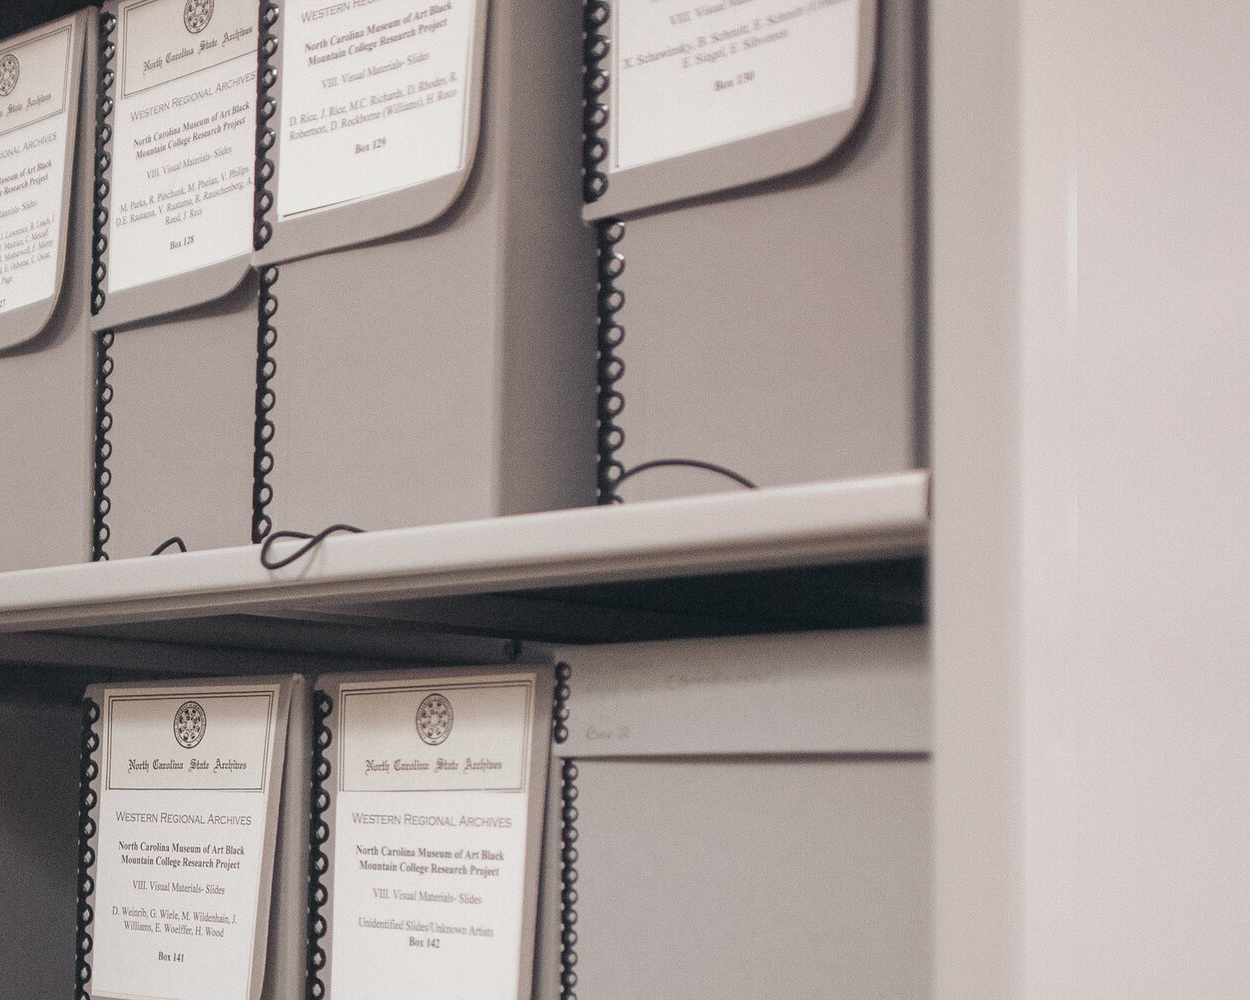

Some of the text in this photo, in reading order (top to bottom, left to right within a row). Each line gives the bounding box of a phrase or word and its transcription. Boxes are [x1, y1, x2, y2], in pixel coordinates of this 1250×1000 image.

[301, 3, 350, 23] WESTERN
[305, 39, 328, 51] North
[330, 30, 364, 46] Carolina
[366, 19, 401, 35] Museum
[414, 10, 427, 20] Art
[429, 1, 452, 16] Black
[308, 18, 447, 66] Mountain College Research Project
[143, 27, 253, 75] North Carolina State Archives
[322, 77, 339, 89] VIII.
[341, 69, 365, 84] Visual
[407, 53, 430, 66] Slides
[130, 70, 256, 122] WESTERN REGIONAL ARCHIVES
[134, 135, 152, 147] North
[153, 127, 181, 141] Carolina
[183, 118, 210, 132] Museum
[219, 109, 231, 119] Art
[231, 102, 250, 115] Black
[136, 117, 245, 159] Mountain College Research Project
[355, 138, 386, 154] Box 129
[147, 168, 161, 179] VIII.
[162, 161, 181, 174] Visual
[214, 146, 232, 158] Slides
[165, 213, 182, 226] Reed,
[170, 235, 194, 250] Box 128
[128, 758, 247, 773] North Carolina State Archives
[365, 759, 502, 775] North Carolina State Archives
[116, 811, 252, 826] WESTERN REGIONAL ARCHIVES
[352, 812, 512, 828] WESTERN REGIONAL ARCHIVES
[119, 841, 138, 850] North
[140, 842, 170, 852] Carolina
[172, 843, 201, 853] Museum
[212, 846, 224, 854] Art
[225, 845, 245, 855] Black
[356, 845, 379, 856] North
[381, 846, 416, 857] Carolina
[418, 848, 452, 859] Museum
[465, 850, 479, 860] Art
[481, 850, 504, 861] Black
[121, 854, 240, 872] Mountain College Research Project
[359, 860, 499, 878] Mountain College Research Project
[132, 880, 147, 890] VIII.
[149, 881, 170, 892] Visual
[205, 884, 225, 895] Slides
[373, 888, 390, 899] VIII.
[393, 889, 417, 901] Visual
[459, 893, 482, 905] Slides
[122, 907, 148, 918] Weinrib,
[159, 909, 180, 921] Wiele,
[193, 912, 230, 924] Wildenhain,
[124, 920, 153, 933] Williams,
[164, 923, 193, 936] Woelffer,
[205, 926, 224, 938] Wood
[358, 917, 494, 937] Unidentified Slides/Unknown Artists
[409, 937, 440, 949] Box 142
[158, 951, 184, 963] Box 141
